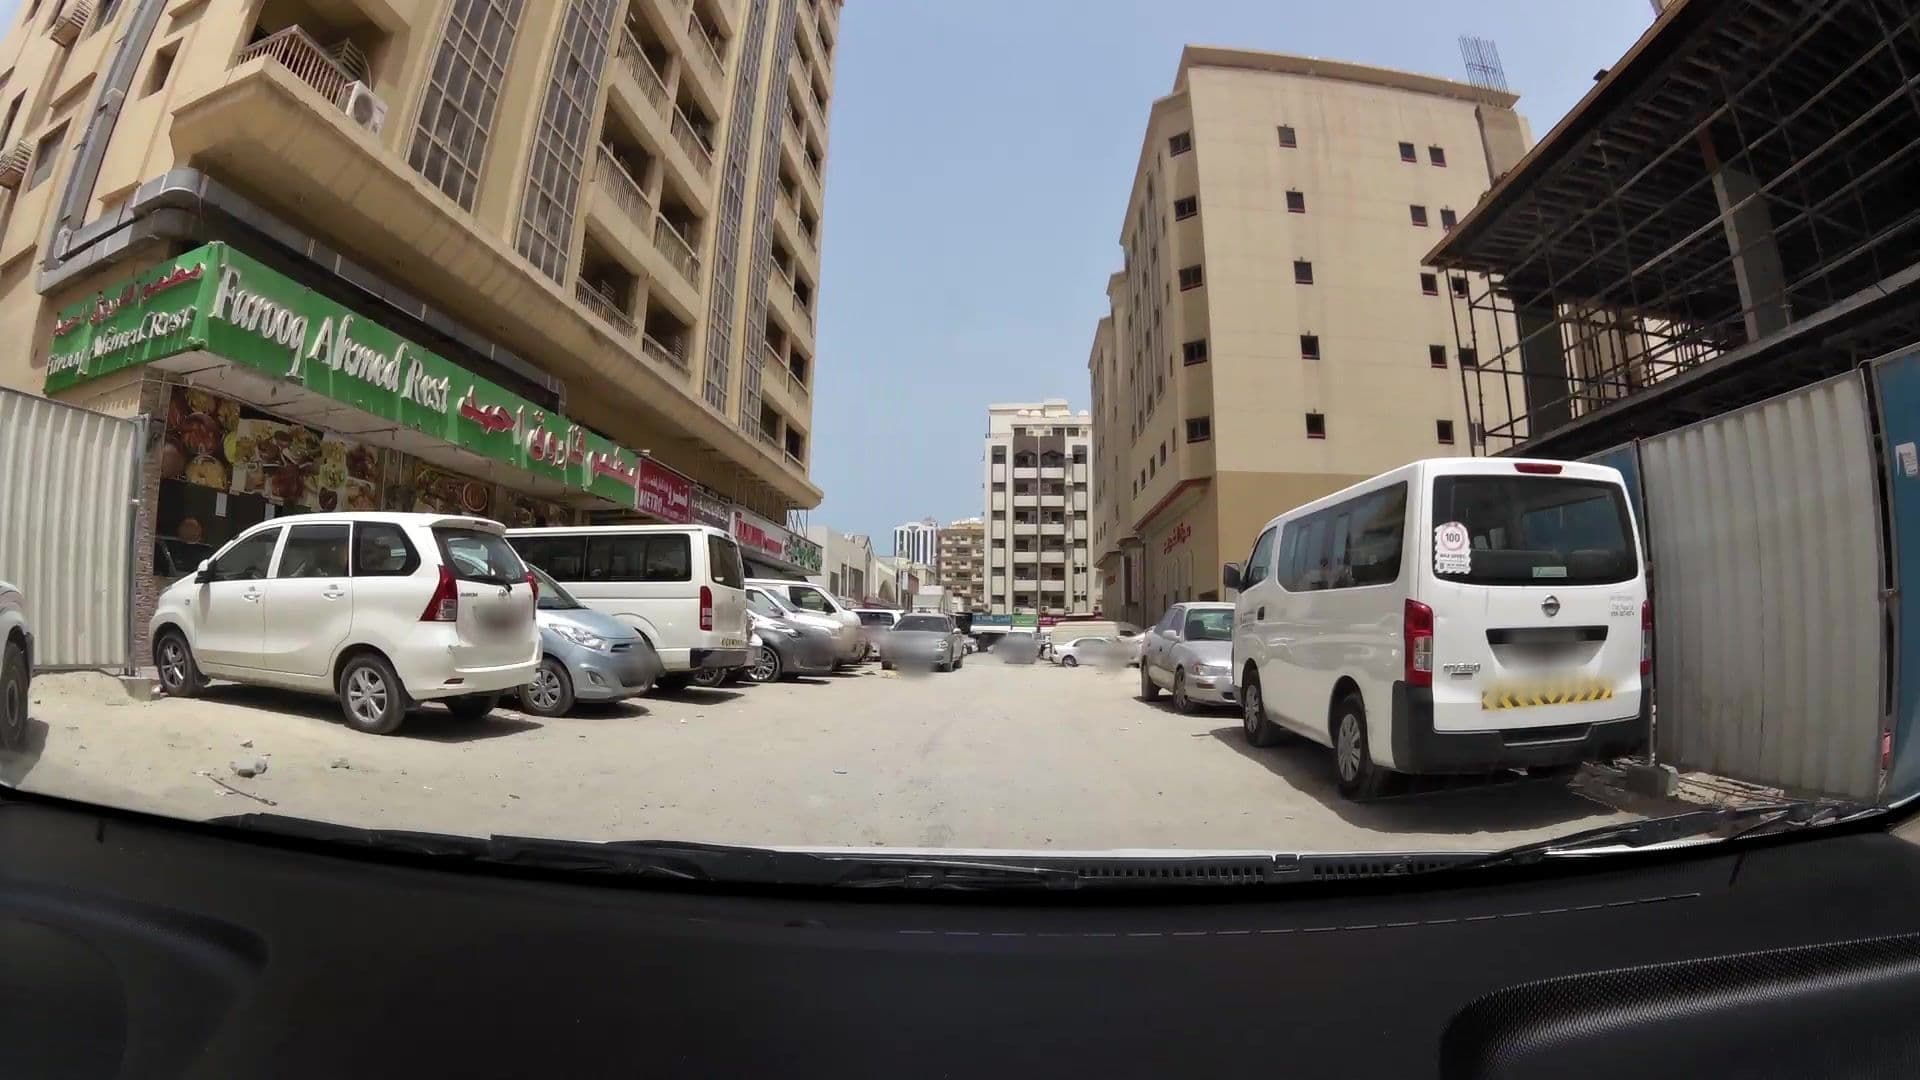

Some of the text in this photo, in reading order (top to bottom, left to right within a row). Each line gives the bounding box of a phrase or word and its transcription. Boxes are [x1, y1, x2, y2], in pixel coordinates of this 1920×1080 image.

[209, 264, 450, 413] Farooq Ahmed Rest
[457, 385, 525, 444] احمد
[526, 410, 585, 470] فاروق
[640, 488, 663, 513] METRO
[1445, 533, 1460, 543] 100
